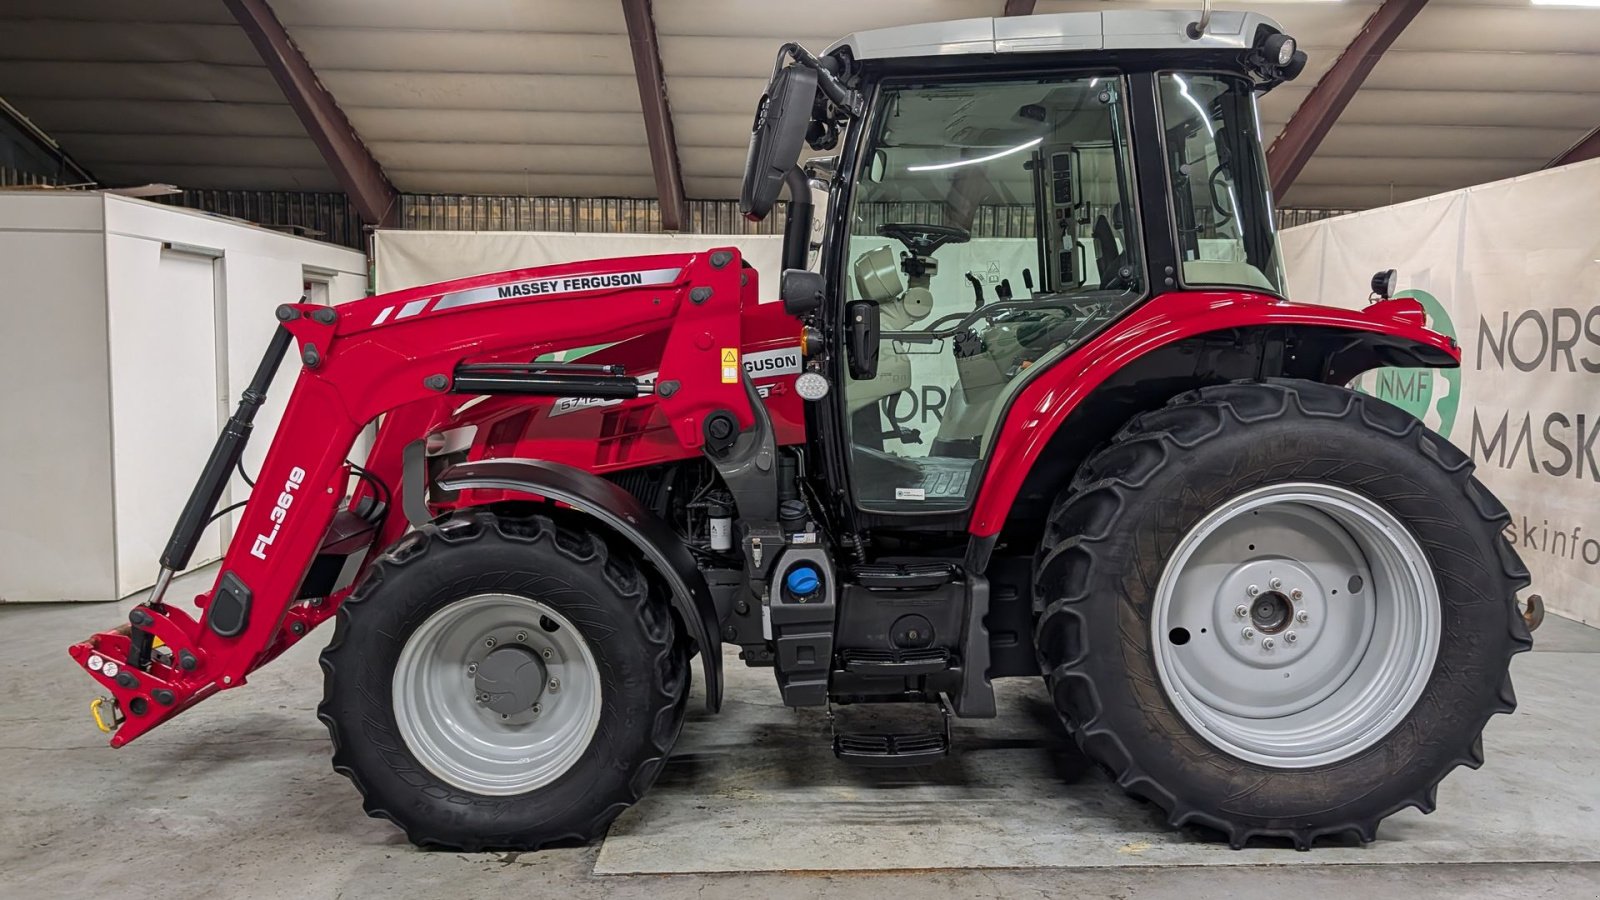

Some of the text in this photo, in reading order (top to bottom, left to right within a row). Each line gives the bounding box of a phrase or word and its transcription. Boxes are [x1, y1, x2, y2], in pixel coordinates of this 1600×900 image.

[498, 273, 643, 298] MASSEY FERGUSON
[743, 355, 797, 373] GUSON
[1380, 369, 1430, 402] NMF
[1471, 406, 1600, 483] MASK
[250, 466, 306, 560] FL.3619
[1503, 516, 1600, 565] skinfo
